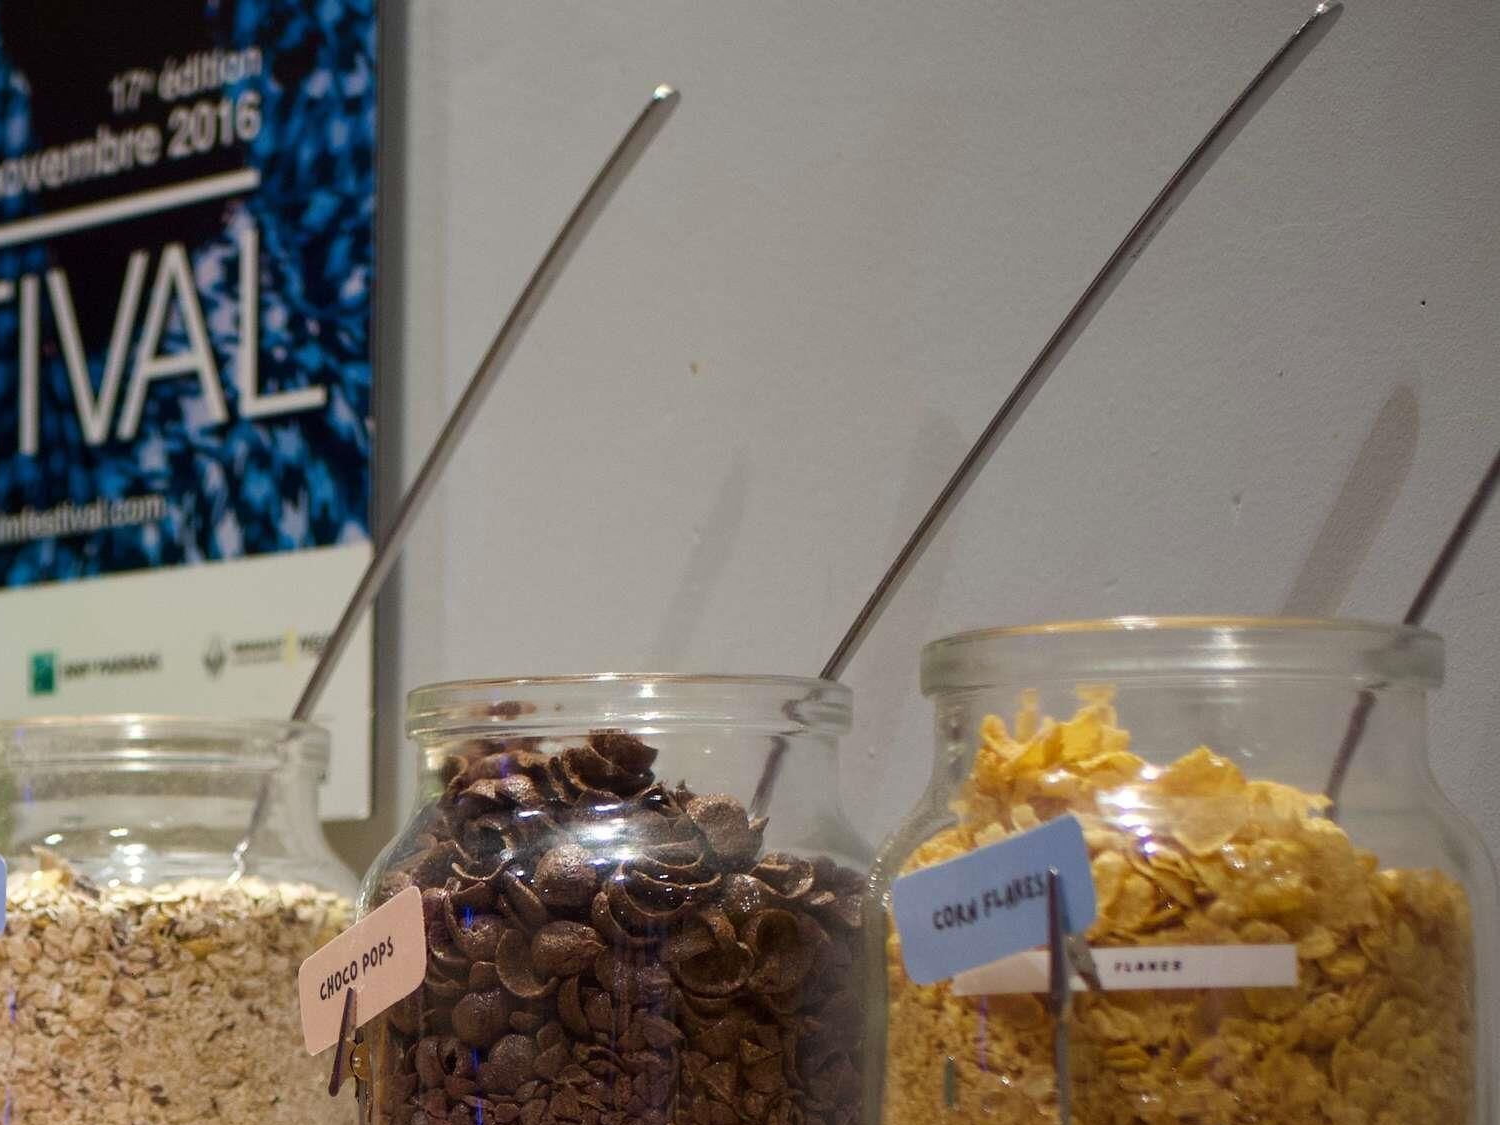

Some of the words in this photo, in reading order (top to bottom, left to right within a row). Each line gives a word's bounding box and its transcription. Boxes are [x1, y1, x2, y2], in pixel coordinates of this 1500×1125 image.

[157, 46, 263, 101] édition
[167, 89, 263, 159] 2016
[932, 898, 979, 930] CORN
[981, 872, 1046, 918] FLAKES
[319, 960, 358, 1001] CHOCO
[362, 935, 394, 976] POPS
